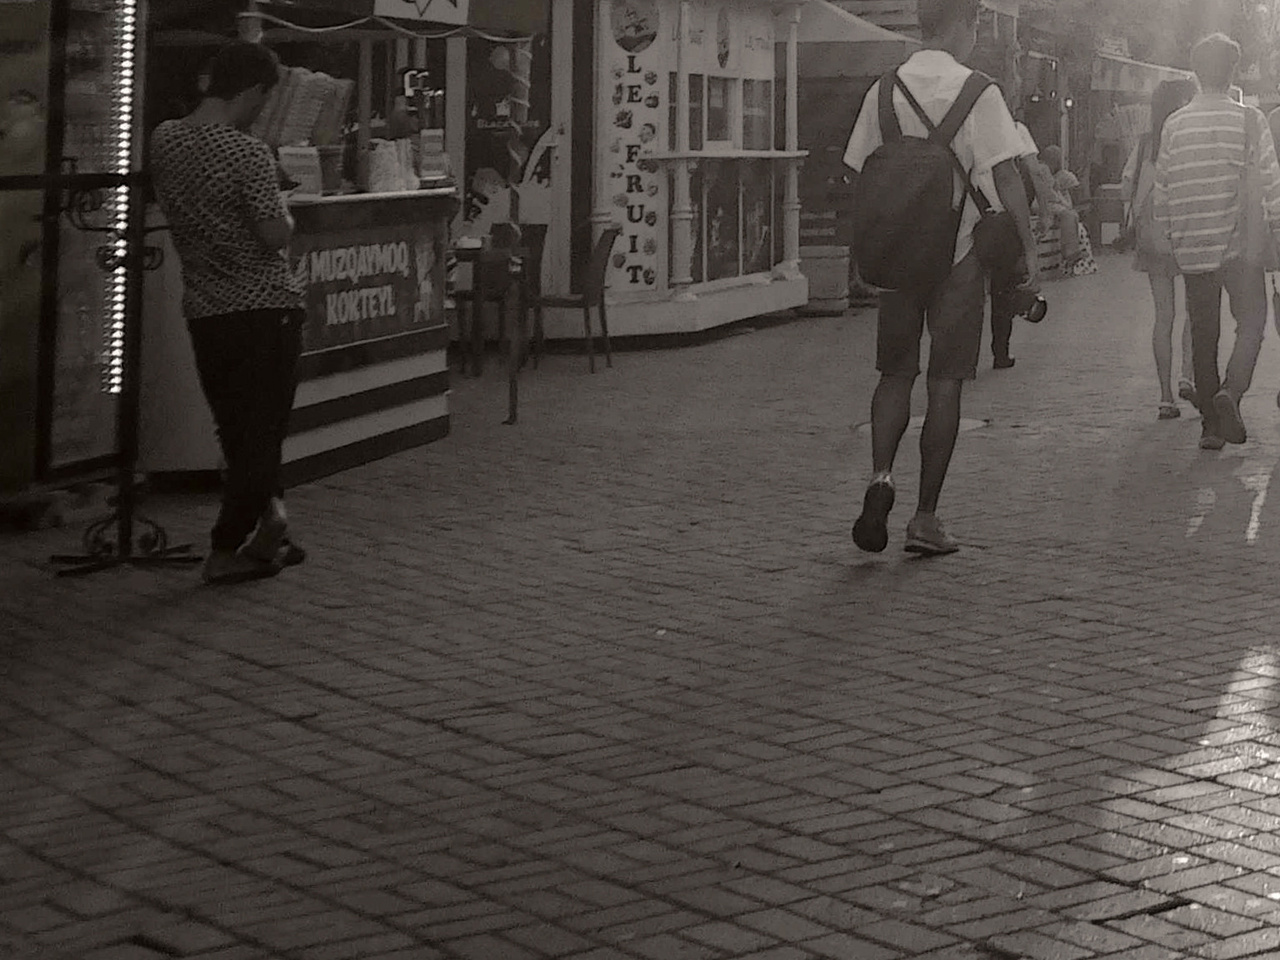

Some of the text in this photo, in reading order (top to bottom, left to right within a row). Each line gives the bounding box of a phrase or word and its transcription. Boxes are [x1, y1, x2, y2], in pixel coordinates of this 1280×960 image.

[625, 55, 646, 285] LE FRUIT
[310, 241, 409, 285] MUZQAYMOQ
[326, 284, 396, 325] KOKTEYL
